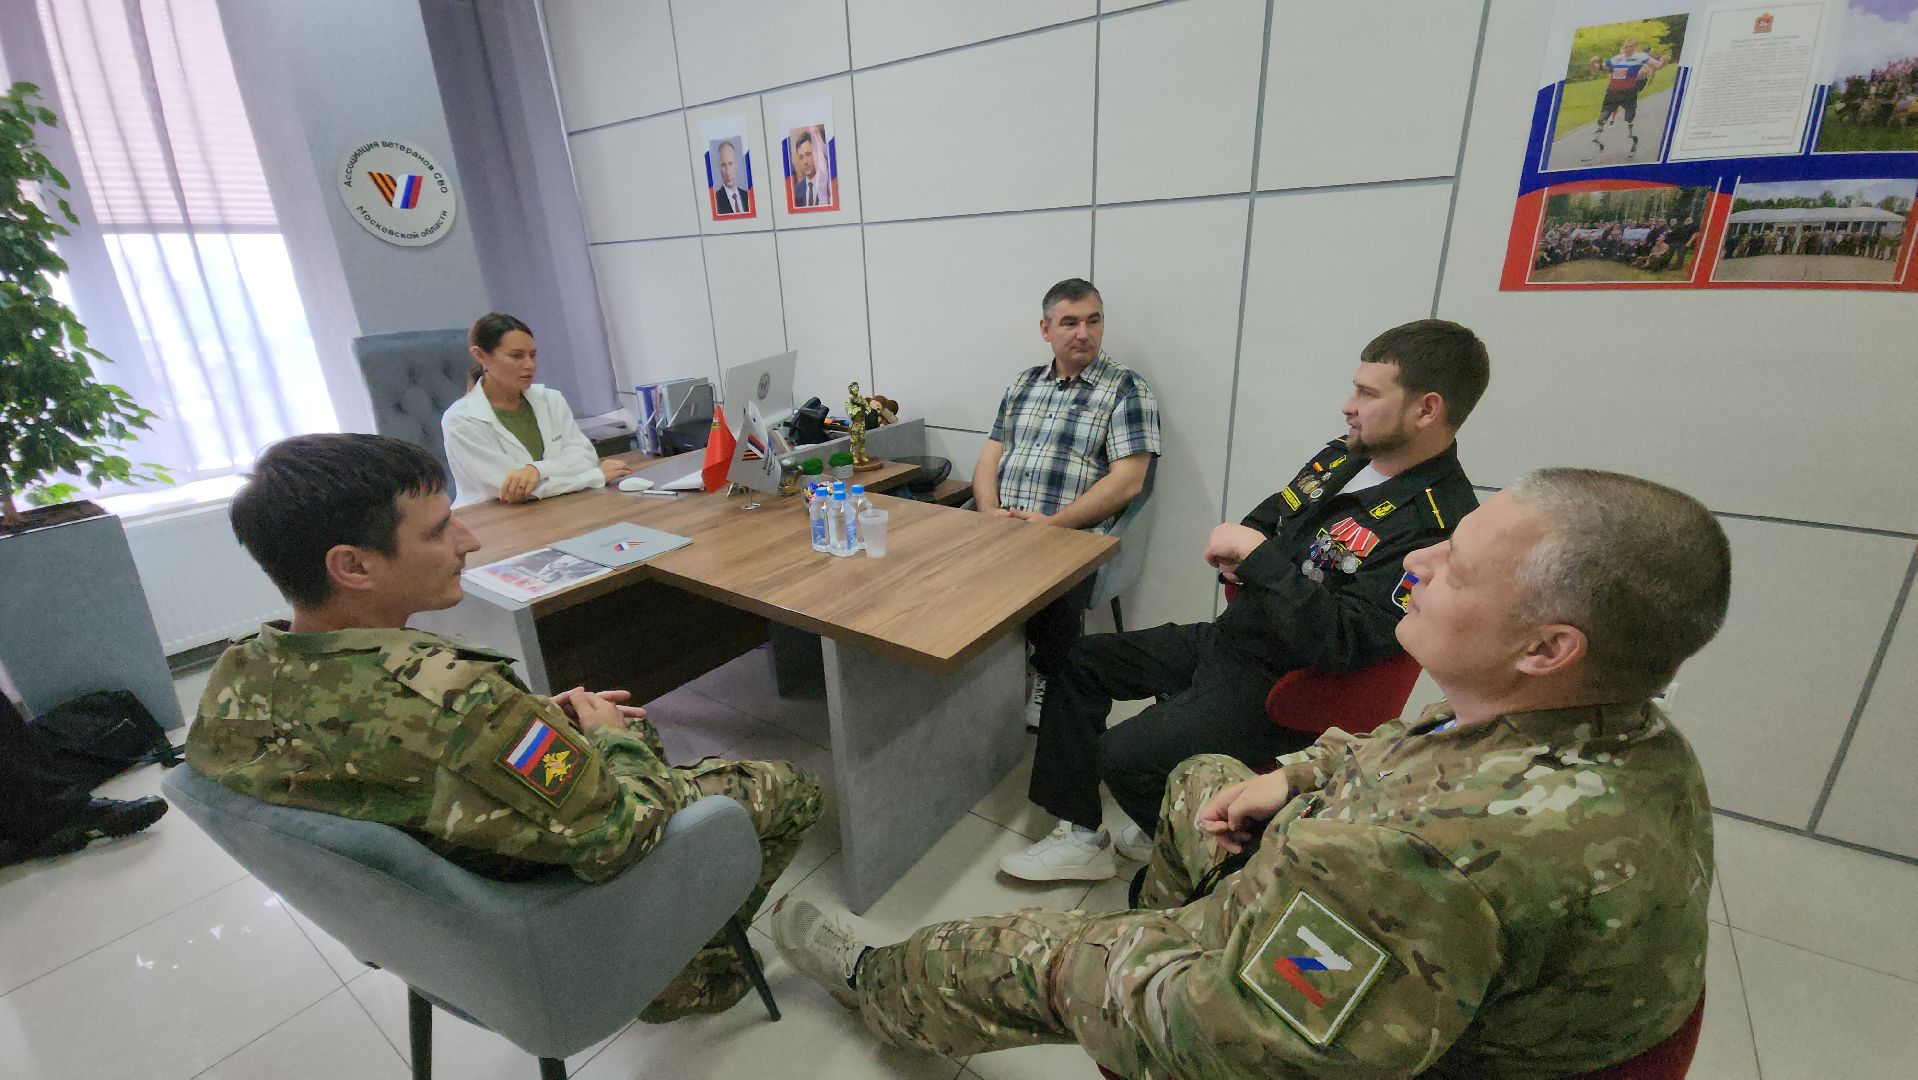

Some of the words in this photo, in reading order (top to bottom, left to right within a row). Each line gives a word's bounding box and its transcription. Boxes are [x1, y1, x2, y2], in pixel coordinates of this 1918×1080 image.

[343, 141, 379, 187] Ассоциация
[381, 140, 434, 171] ветеранов
[433, 172, 448, 194] СВО
[357, 205, 419, 239] Московской
[420, 210, 448, 238] области
